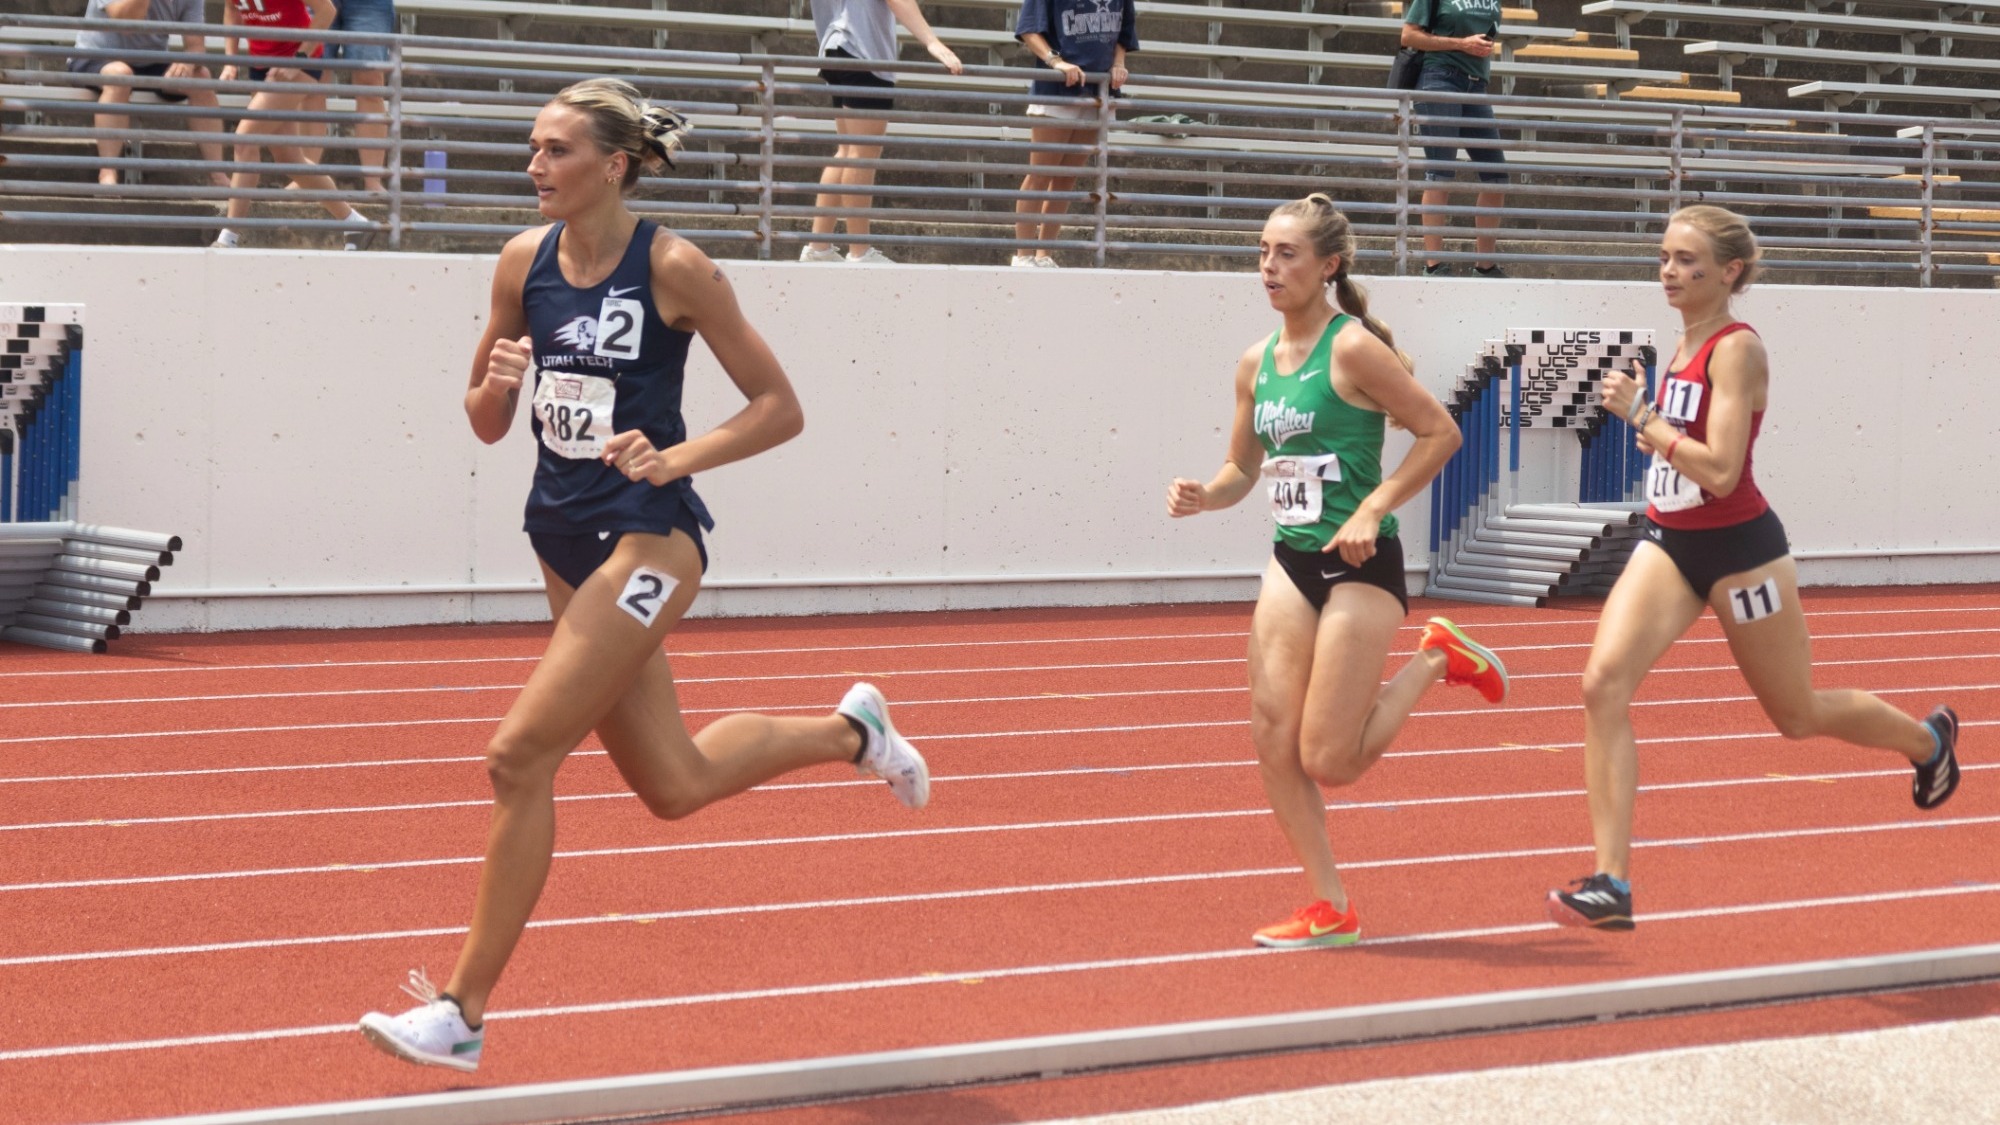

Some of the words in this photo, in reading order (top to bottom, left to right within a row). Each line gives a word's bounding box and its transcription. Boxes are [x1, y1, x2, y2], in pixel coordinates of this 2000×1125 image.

[1451, 0, 1500, 12] TRACK
[602, 309, 634, 354] 2
[1563, 331, 1601, 344] UCS
[1546, 344, 1587, 356] UCS
[541, 354, 575, 368] UTAH
[576, 354, 614, 369] TECH
[1538, 356, 1578, 368] UCS
[1527, 368, 1568, 380] UCS
[1668, 380, 1693, 418] 11
[543, 402, 595, 442] 382
[1274, 481, 1308, 511] 404
[625, 574, 663, 618] 2
[1735, 583, 1773, 620] 11
